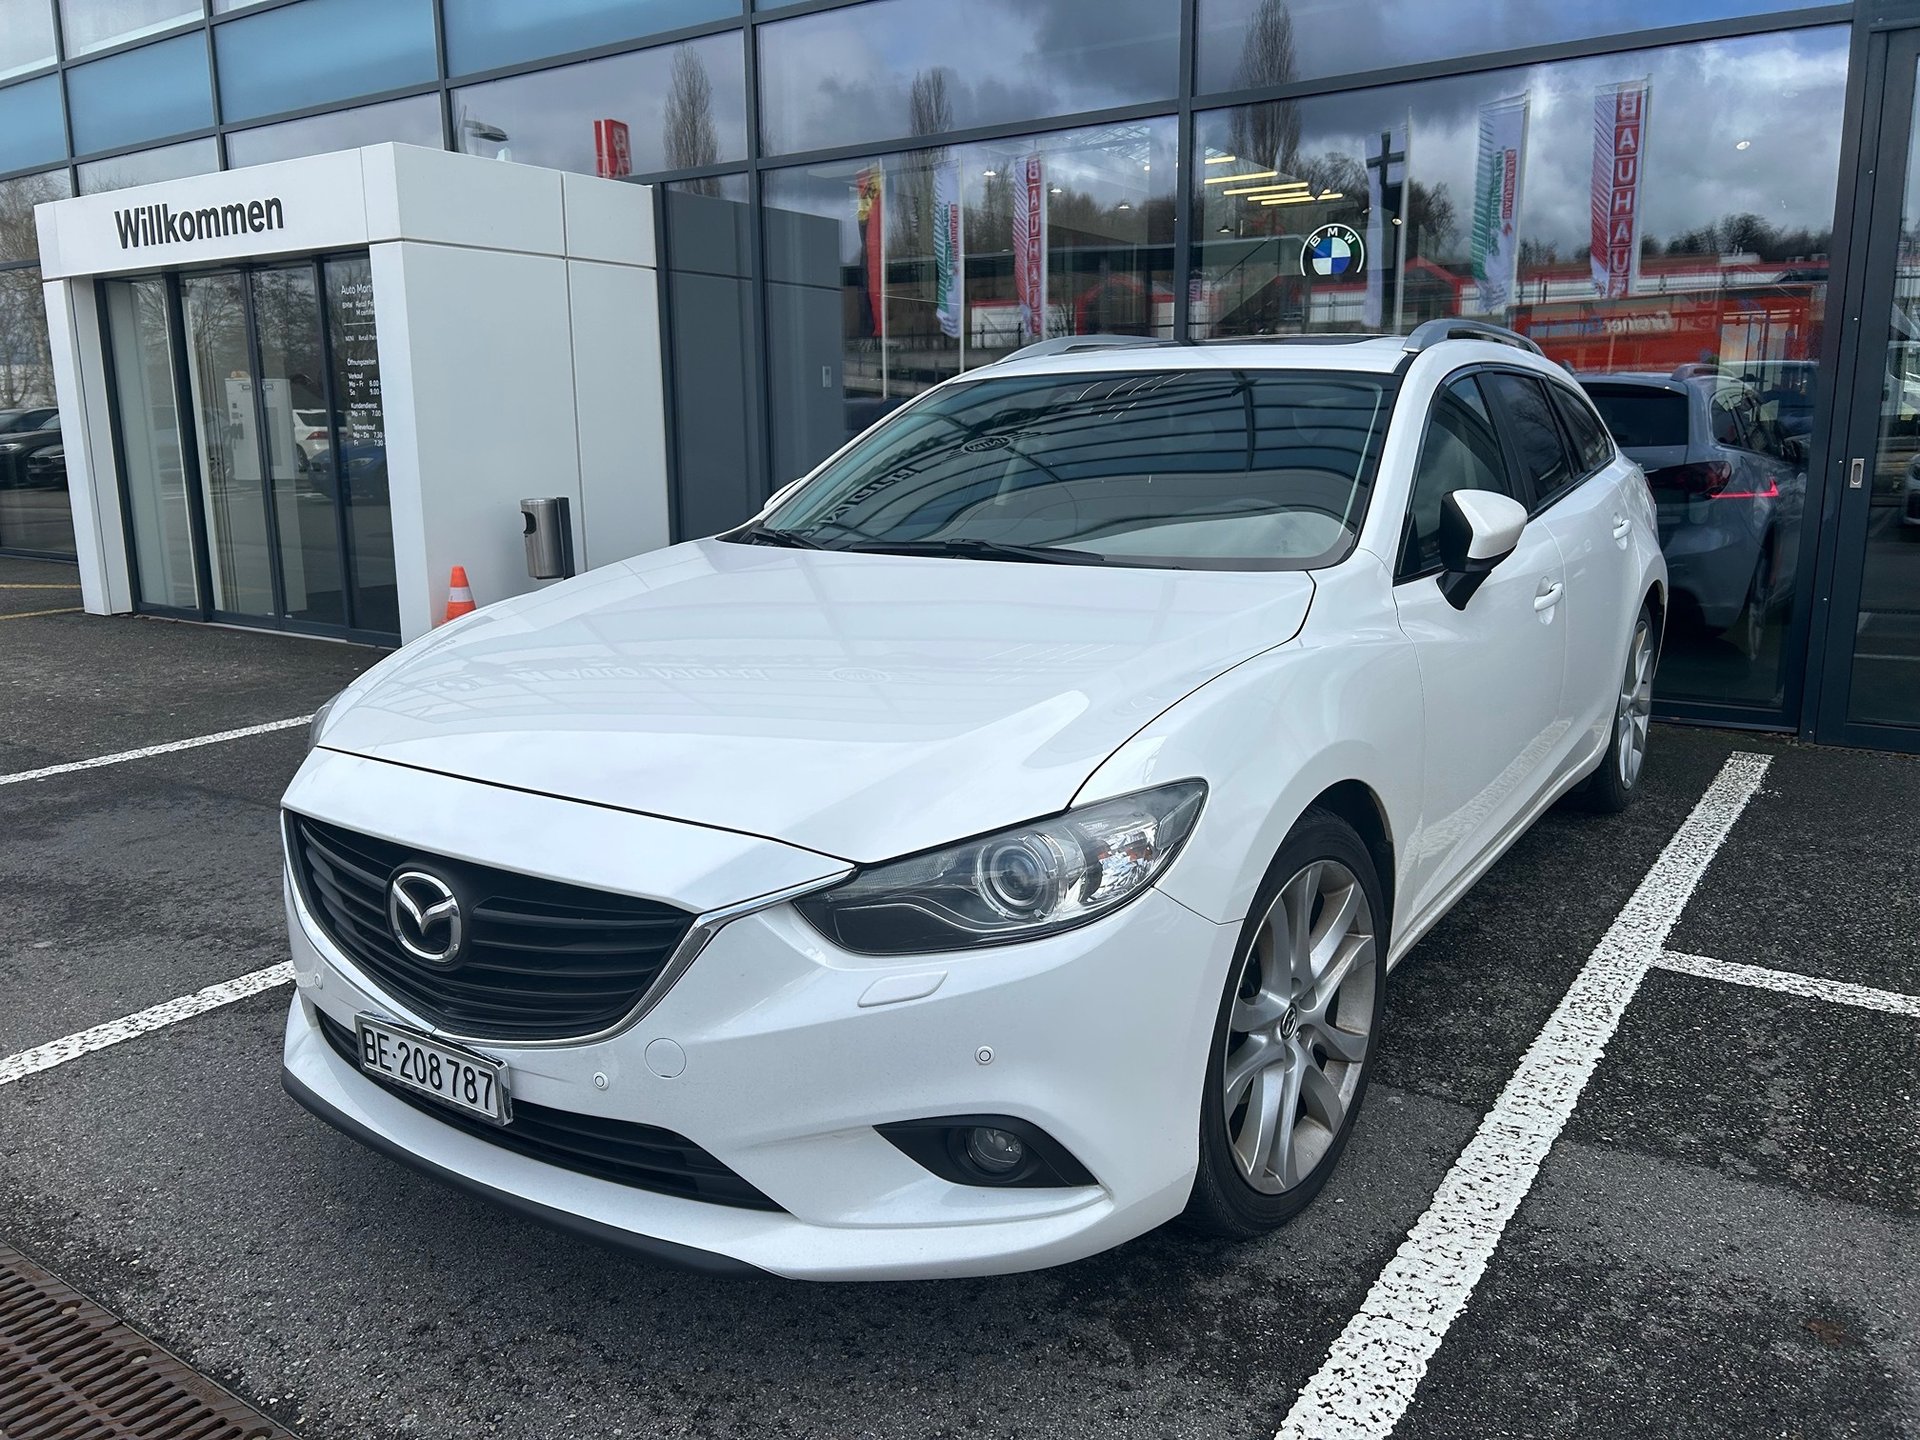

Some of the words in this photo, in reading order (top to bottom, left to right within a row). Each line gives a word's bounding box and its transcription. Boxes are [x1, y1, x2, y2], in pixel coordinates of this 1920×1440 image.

[114, 197, 284, 249] Willkommen
[1310, 227, 1357, 248] BMW
[341, 285, 355, 295] Auto
[347, 358, 376, 366] Öffnungszeiten
[353, 423, 376, 431] Teileverkauf
